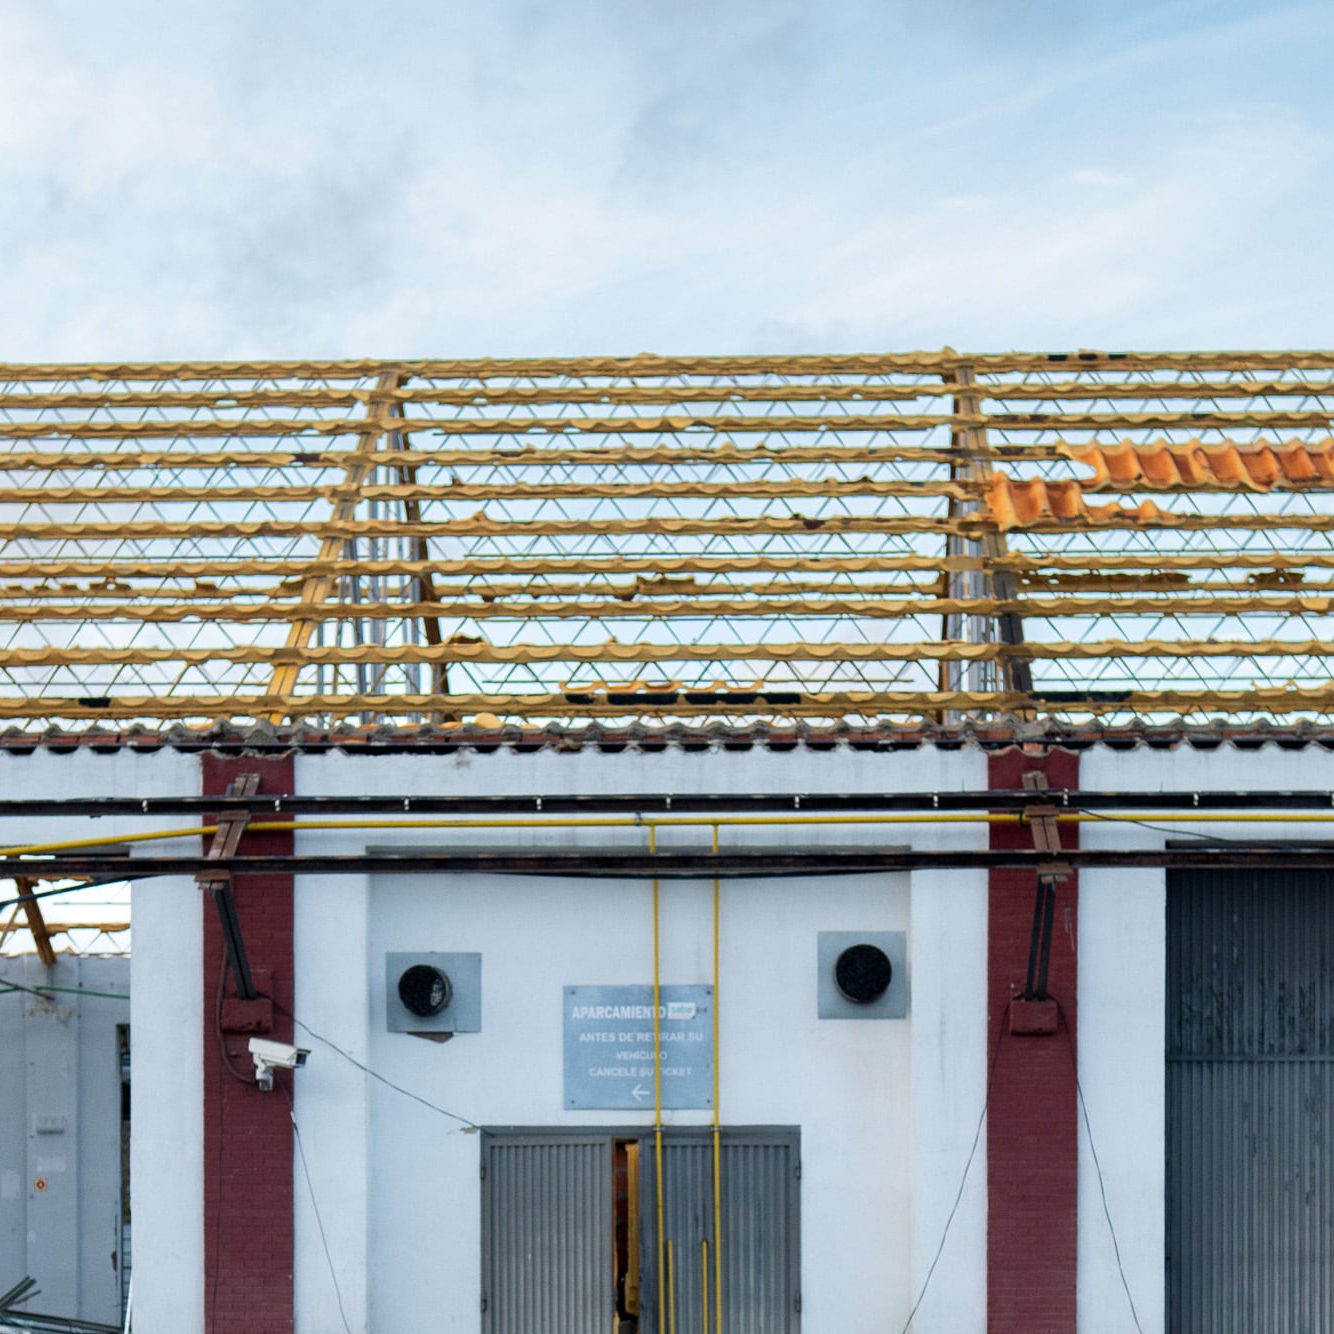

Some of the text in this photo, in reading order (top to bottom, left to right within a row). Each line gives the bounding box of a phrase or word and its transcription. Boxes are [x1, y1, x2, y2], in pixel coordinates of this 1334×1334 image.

[579, 1032, 616, 1041] ANTES
[618, 1032, 634, 1041] DE
[688, 1032, 703, 1041] SU
[589, 1067, 637, 1077] CANCELE
[639, 1067, 653, 1077] SU
